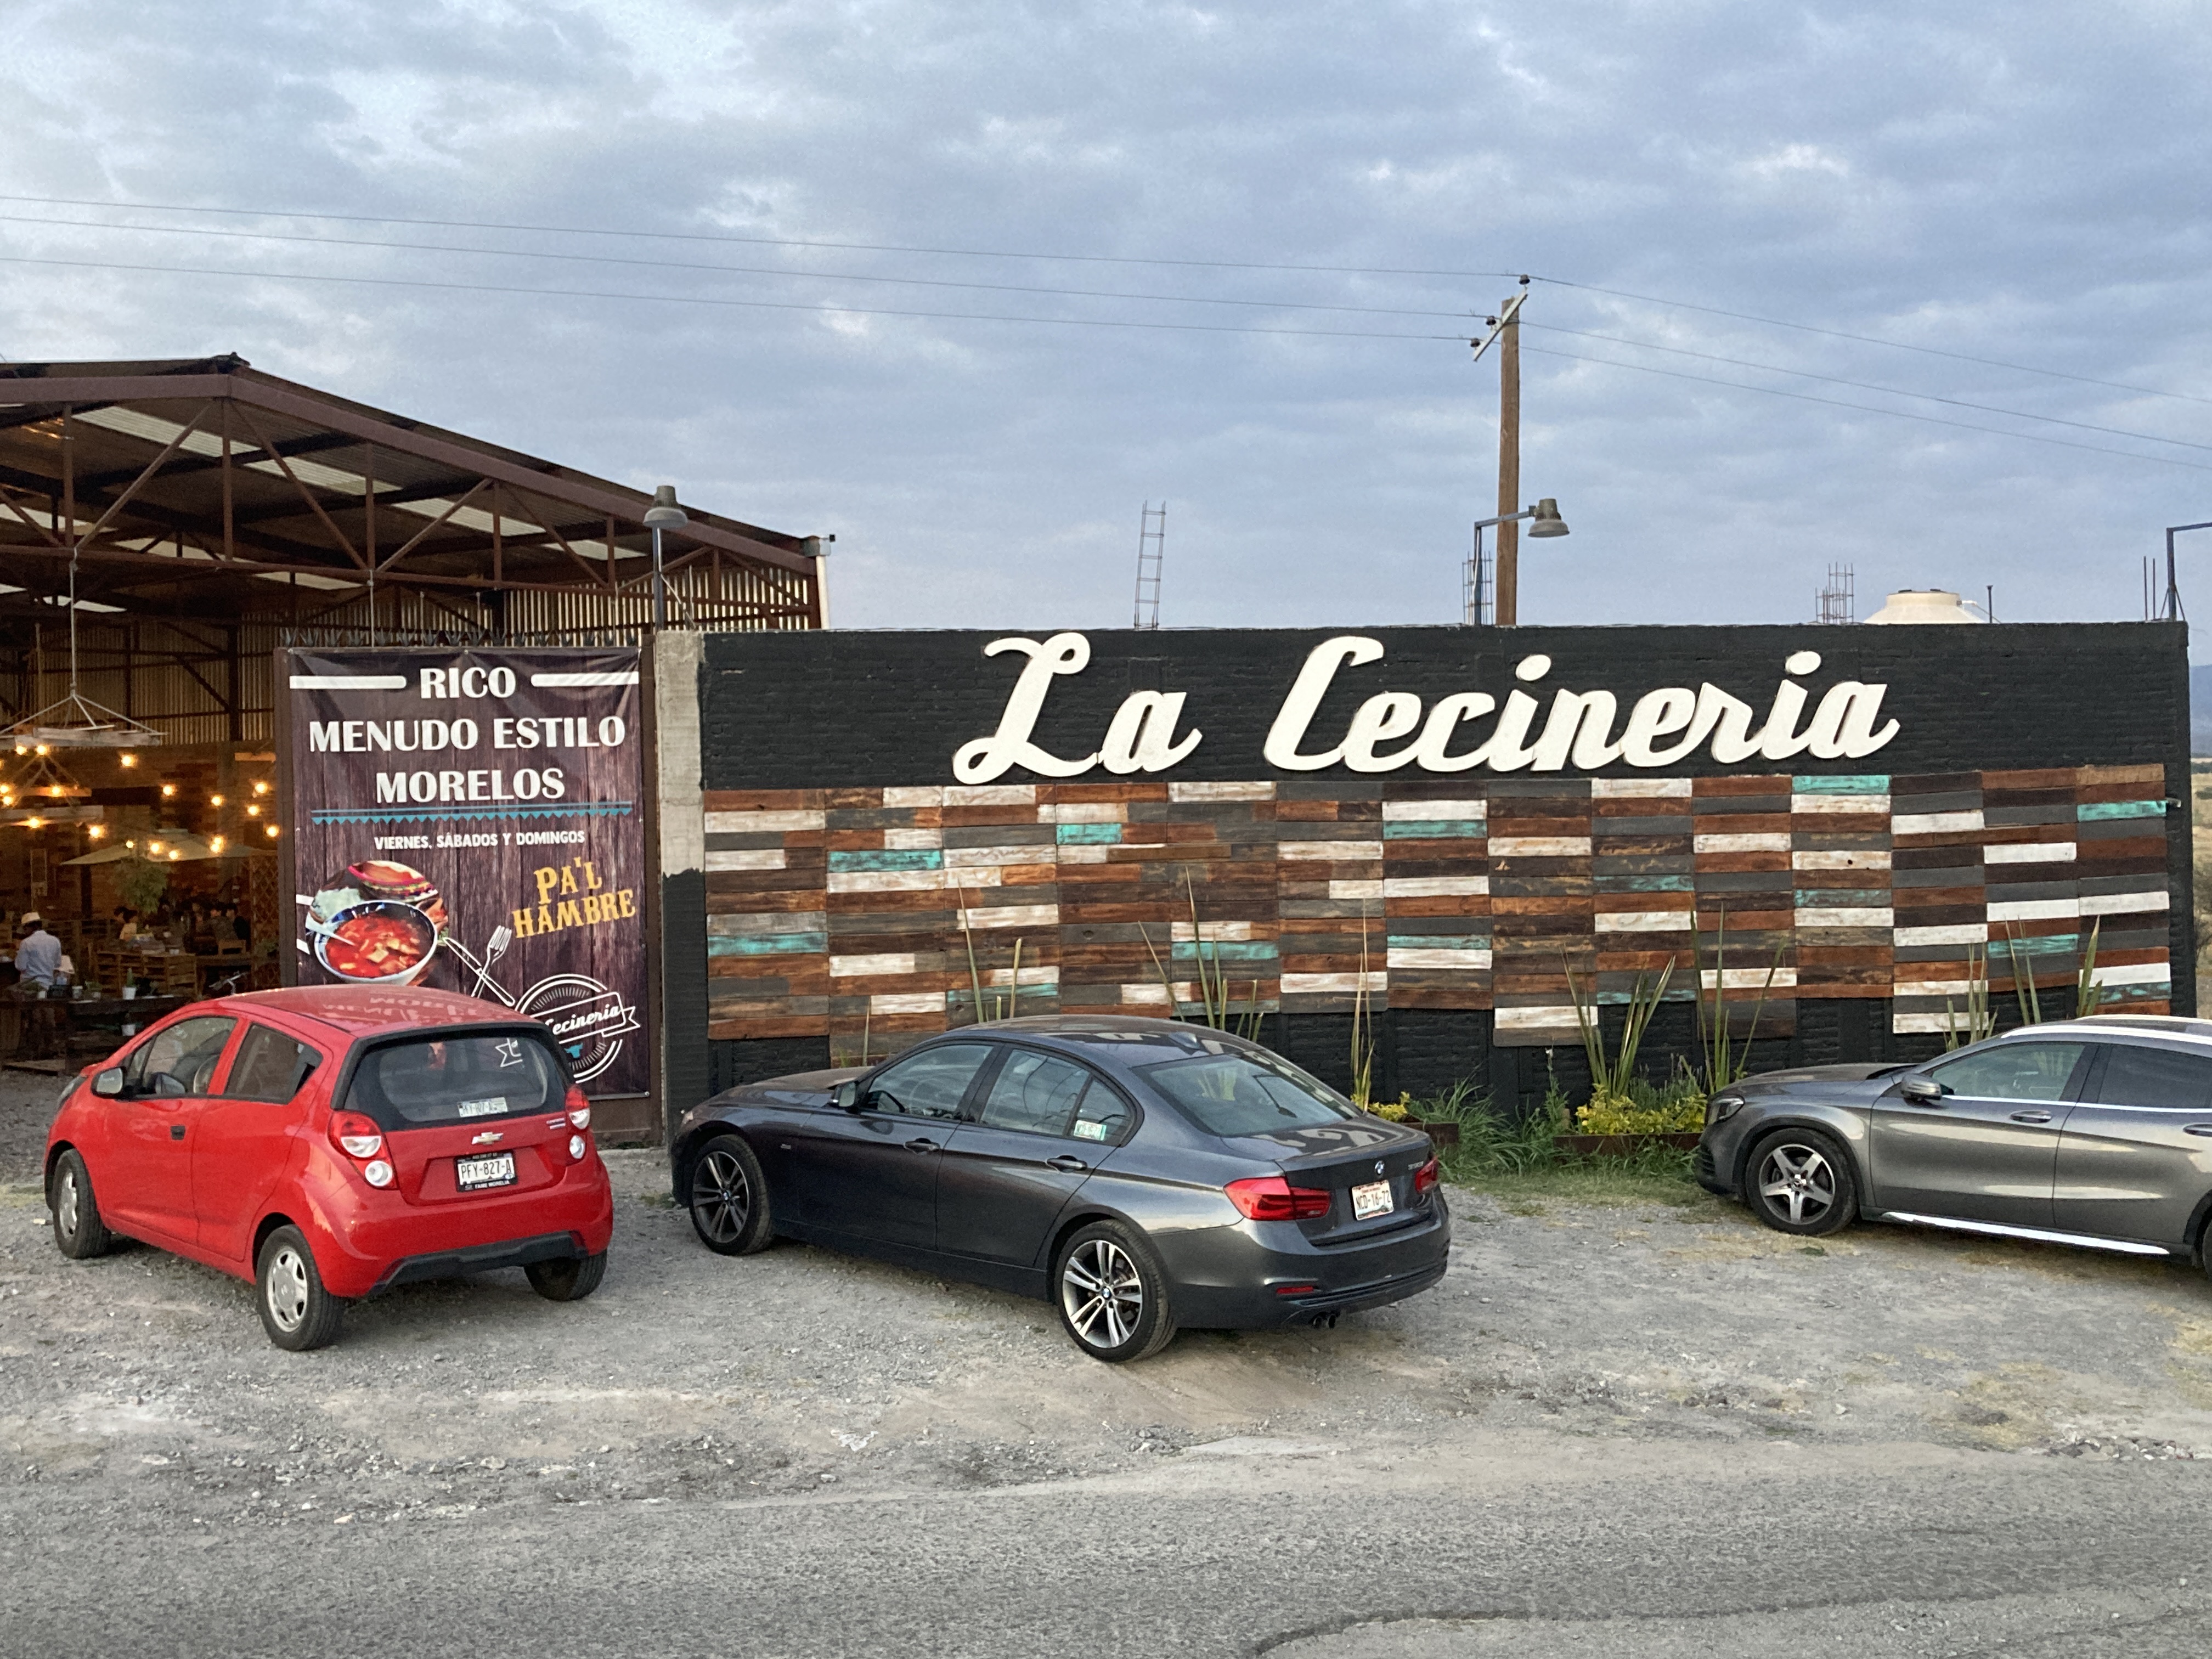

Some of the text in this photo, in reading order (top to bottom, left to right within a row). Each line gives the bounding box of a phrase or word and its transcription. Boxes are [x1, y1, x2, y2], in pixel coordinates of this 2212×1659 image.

[420, 667, 516, 699] RICO
[952, 632, 1900, 785] La Cecineria
[309, 715, 625, 752] MENUDO ESTILO
[376, 768, 565, 803] MORELOS
[436, 832, 498, 848] SÁBADOS
[502, 832, 512, 847] Y
[516, 830, 586, 845] DOMINGOS
[533, 856, 602, 905] PA'L
[511, 889, 636, 938] HAMBRE
[461, 1159, 512, 1179] PFY-827-A
